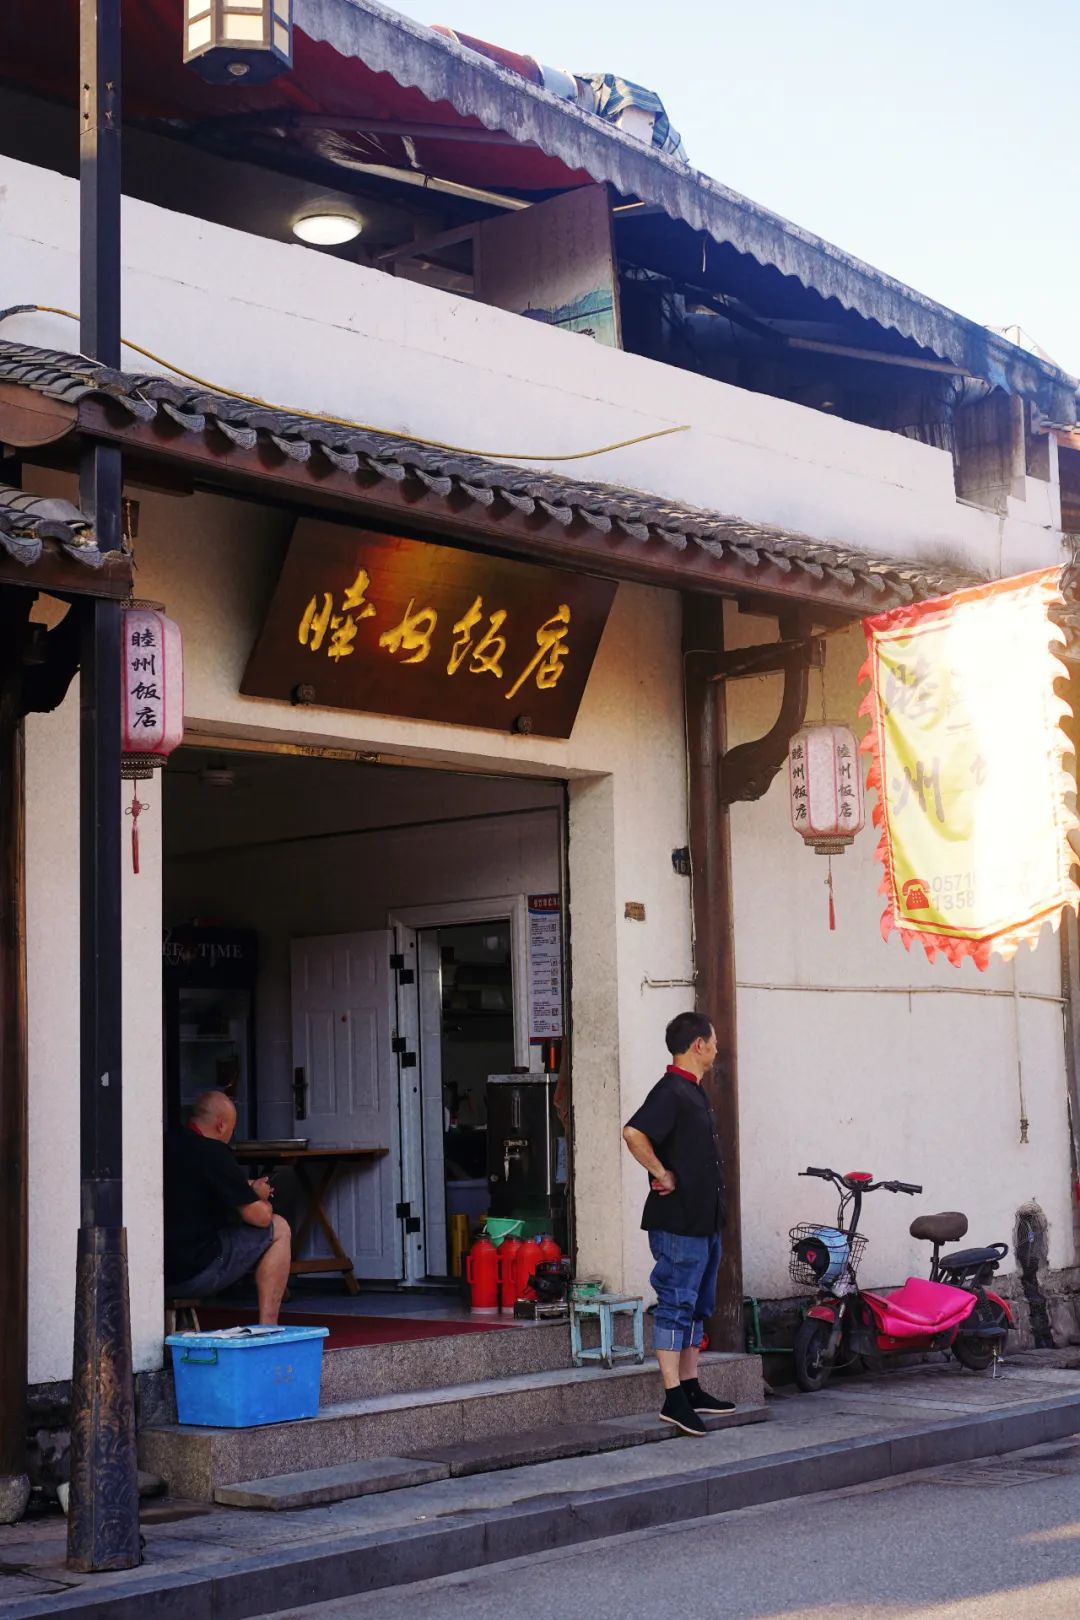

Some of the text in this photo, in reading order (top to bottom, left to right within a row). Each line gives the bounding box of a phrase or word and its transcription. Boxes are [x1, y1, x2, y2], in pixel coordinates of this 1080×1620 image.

[130, 628, 161, 729] 睦州饭店
[791, 744, 808, 821] 睦州饭店
[932, 872, 976, 893] 0571
